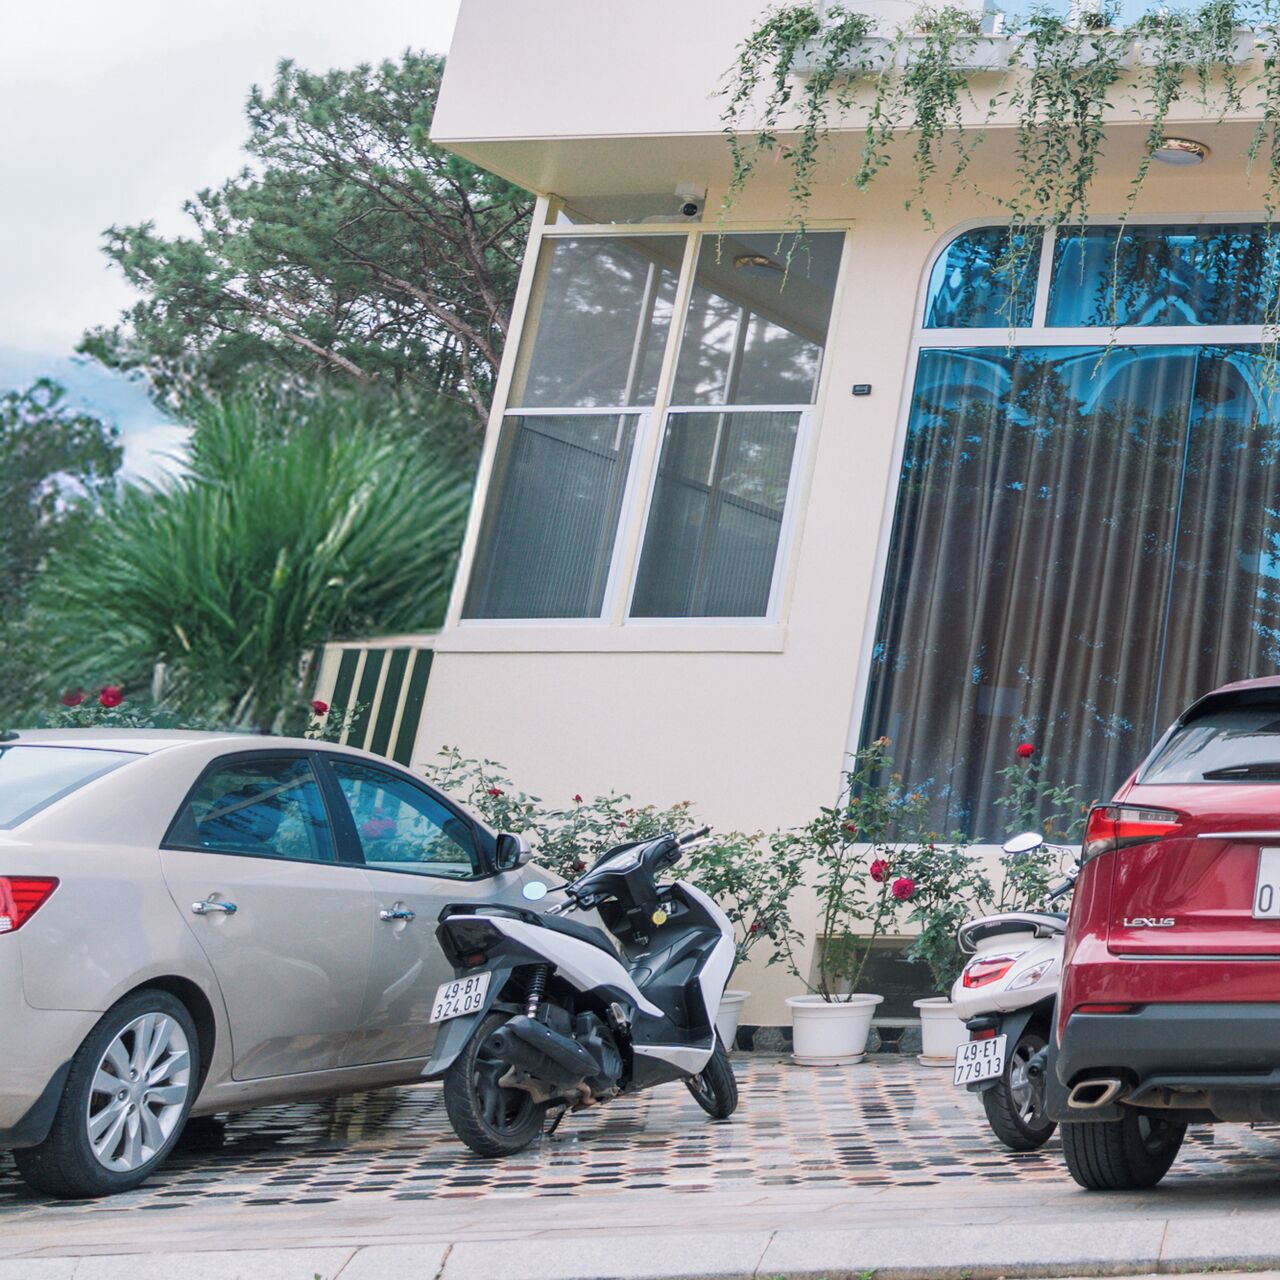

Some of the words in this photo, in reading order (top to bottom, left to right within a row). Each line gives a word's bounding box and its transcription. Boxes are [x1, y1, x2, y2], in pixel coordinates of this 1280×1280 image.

[1123, 917, 1176, 928] LEXUS
[444, 977, 480, 1000] 49-B1
[434, 992, 482, 1020] 324.09
[963, 1039, 997, 1062] 49-E1
[956, 1057, 1001, 1083] 779.13
